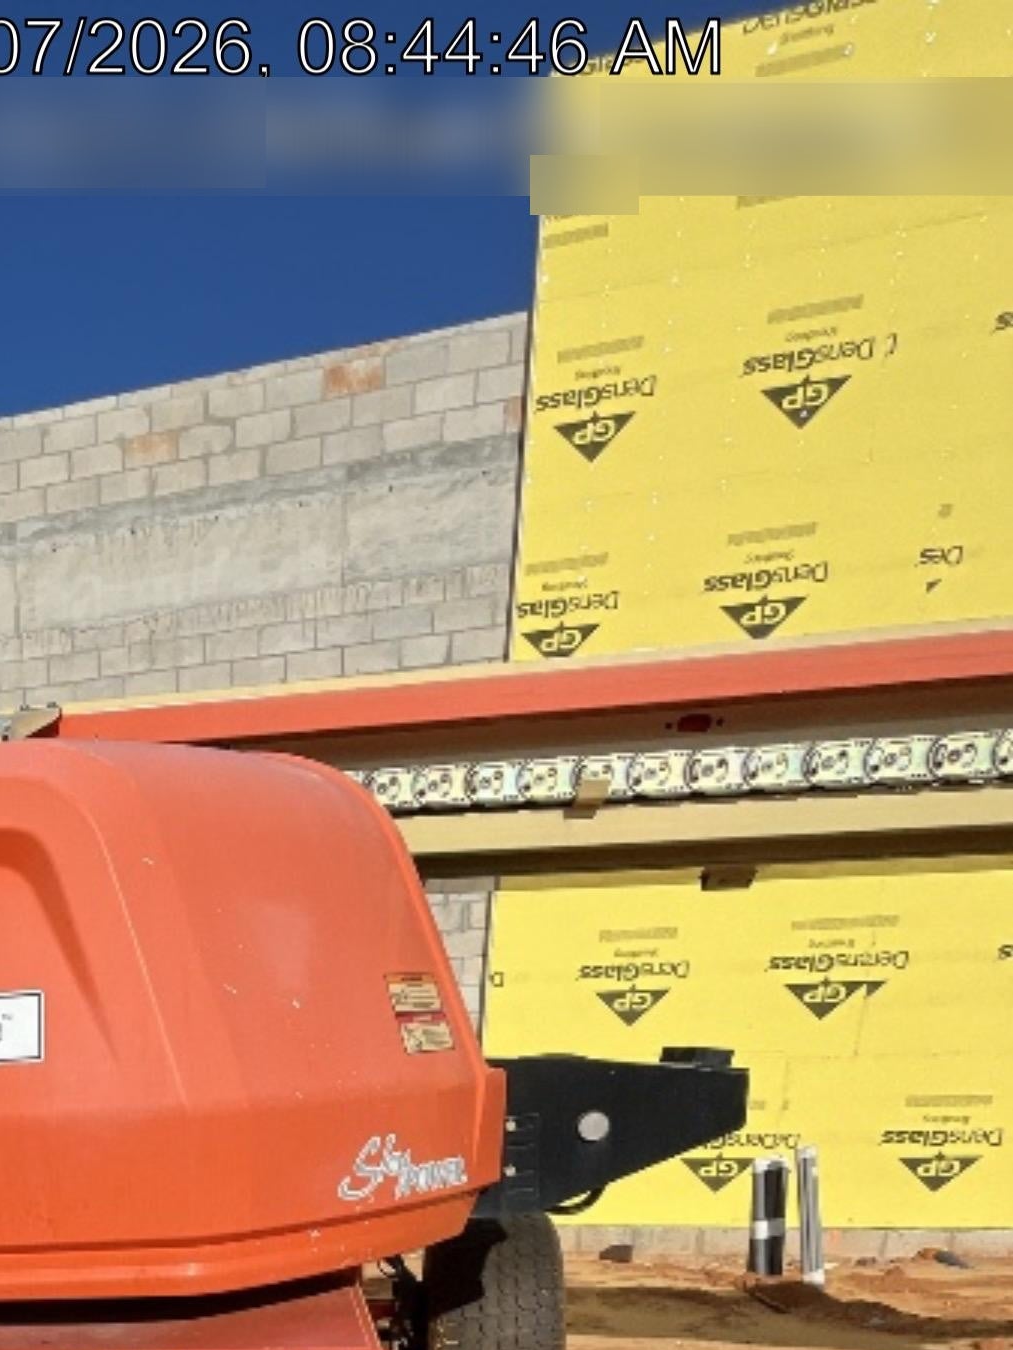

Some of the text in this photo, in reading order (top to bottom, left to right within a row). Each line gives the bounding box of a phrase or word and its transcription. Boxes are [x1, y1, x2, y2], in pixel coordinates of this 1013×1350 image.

[741, 336, 874, 378] DensGlass
[535, 375, 657, 413] DensGlass
[703, 561, 829, 593] DensGlass
[578, 960, 690, 980] DensGlass
[880, 1127, 1003, 1148] DensGlass
